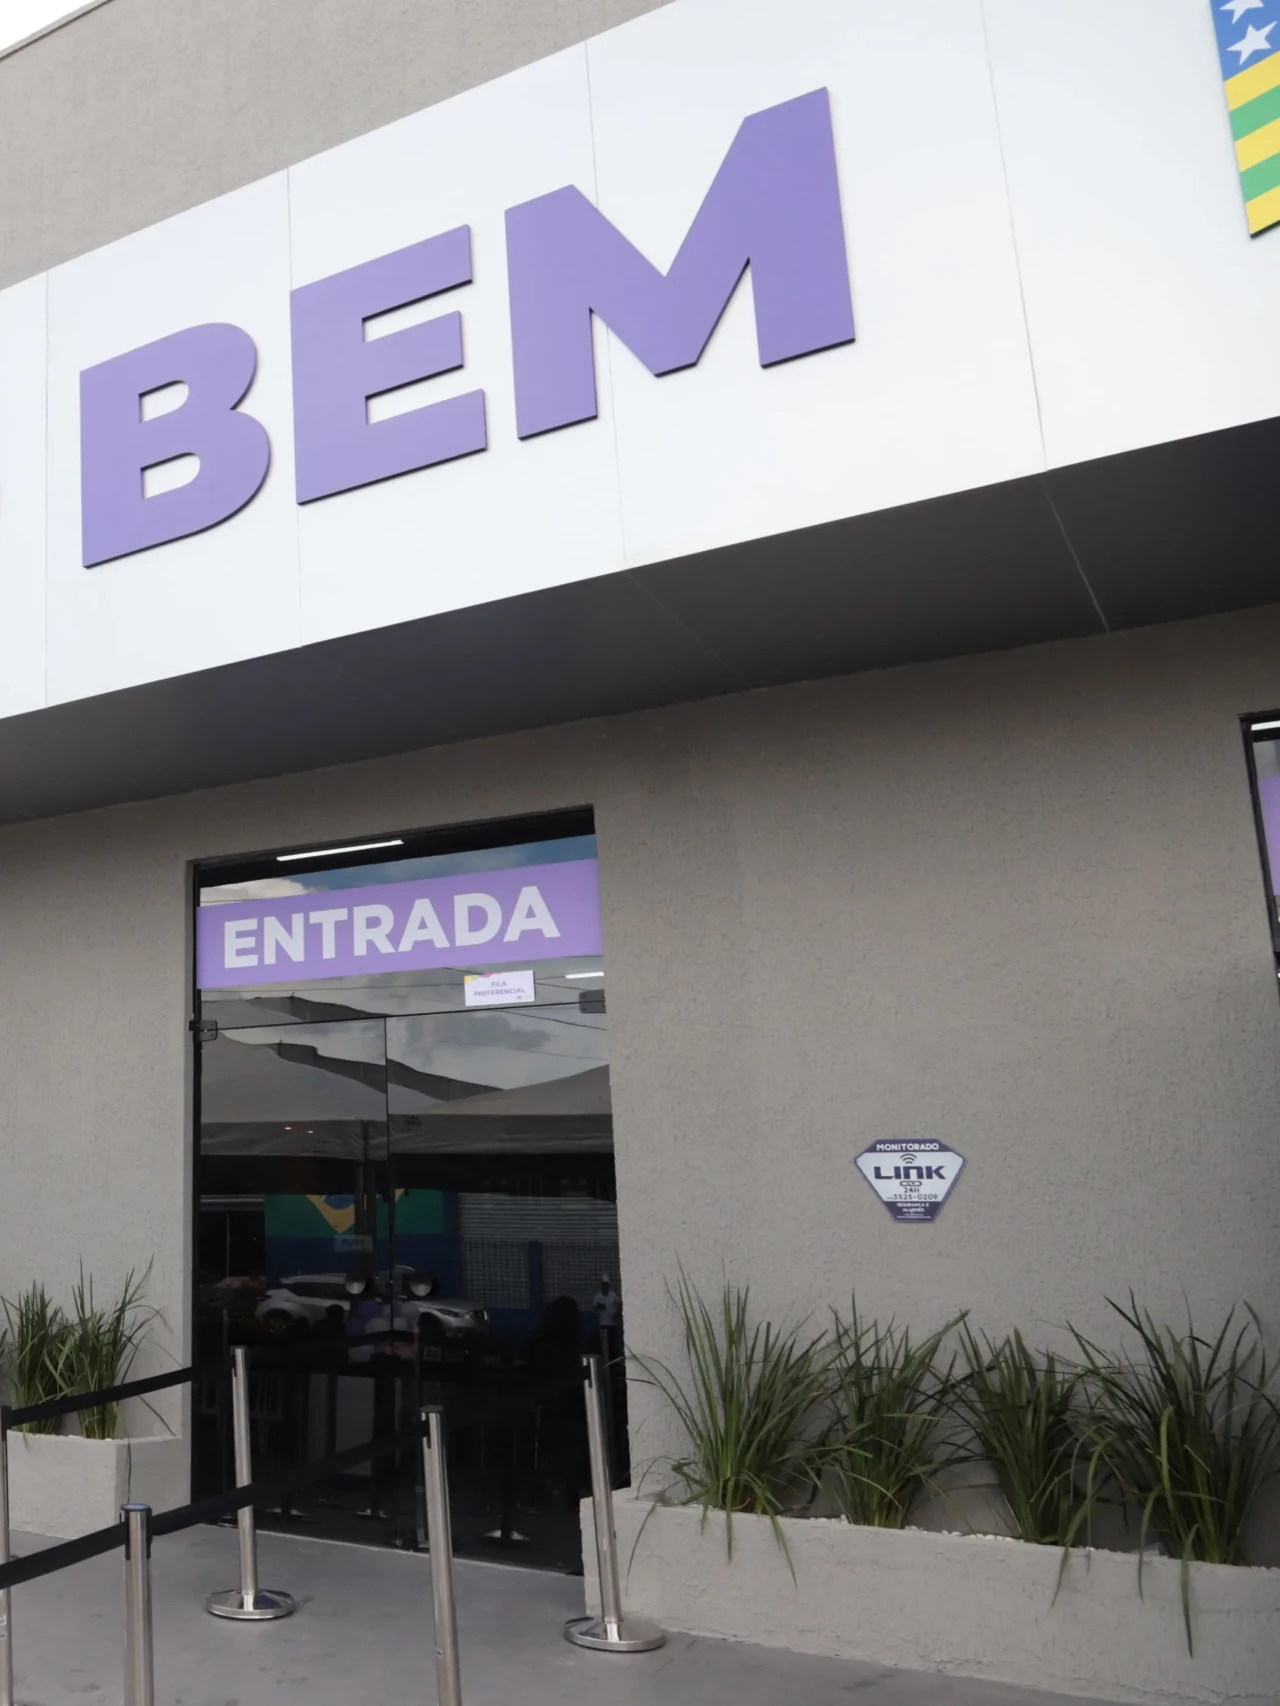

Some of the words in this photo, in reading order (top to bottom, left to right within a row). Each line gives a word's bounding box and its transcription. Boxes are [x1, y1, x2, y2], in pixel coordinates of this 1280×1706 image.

[80, 87, 857, 569] BEM
[223, 886, 561, 969] ENTRADA
[473, 988, 526, 997] PREFERENCIAL
[876, 1143, 940, 1151] MONITORADO
[873, 1166, 947, 1180] LINK
